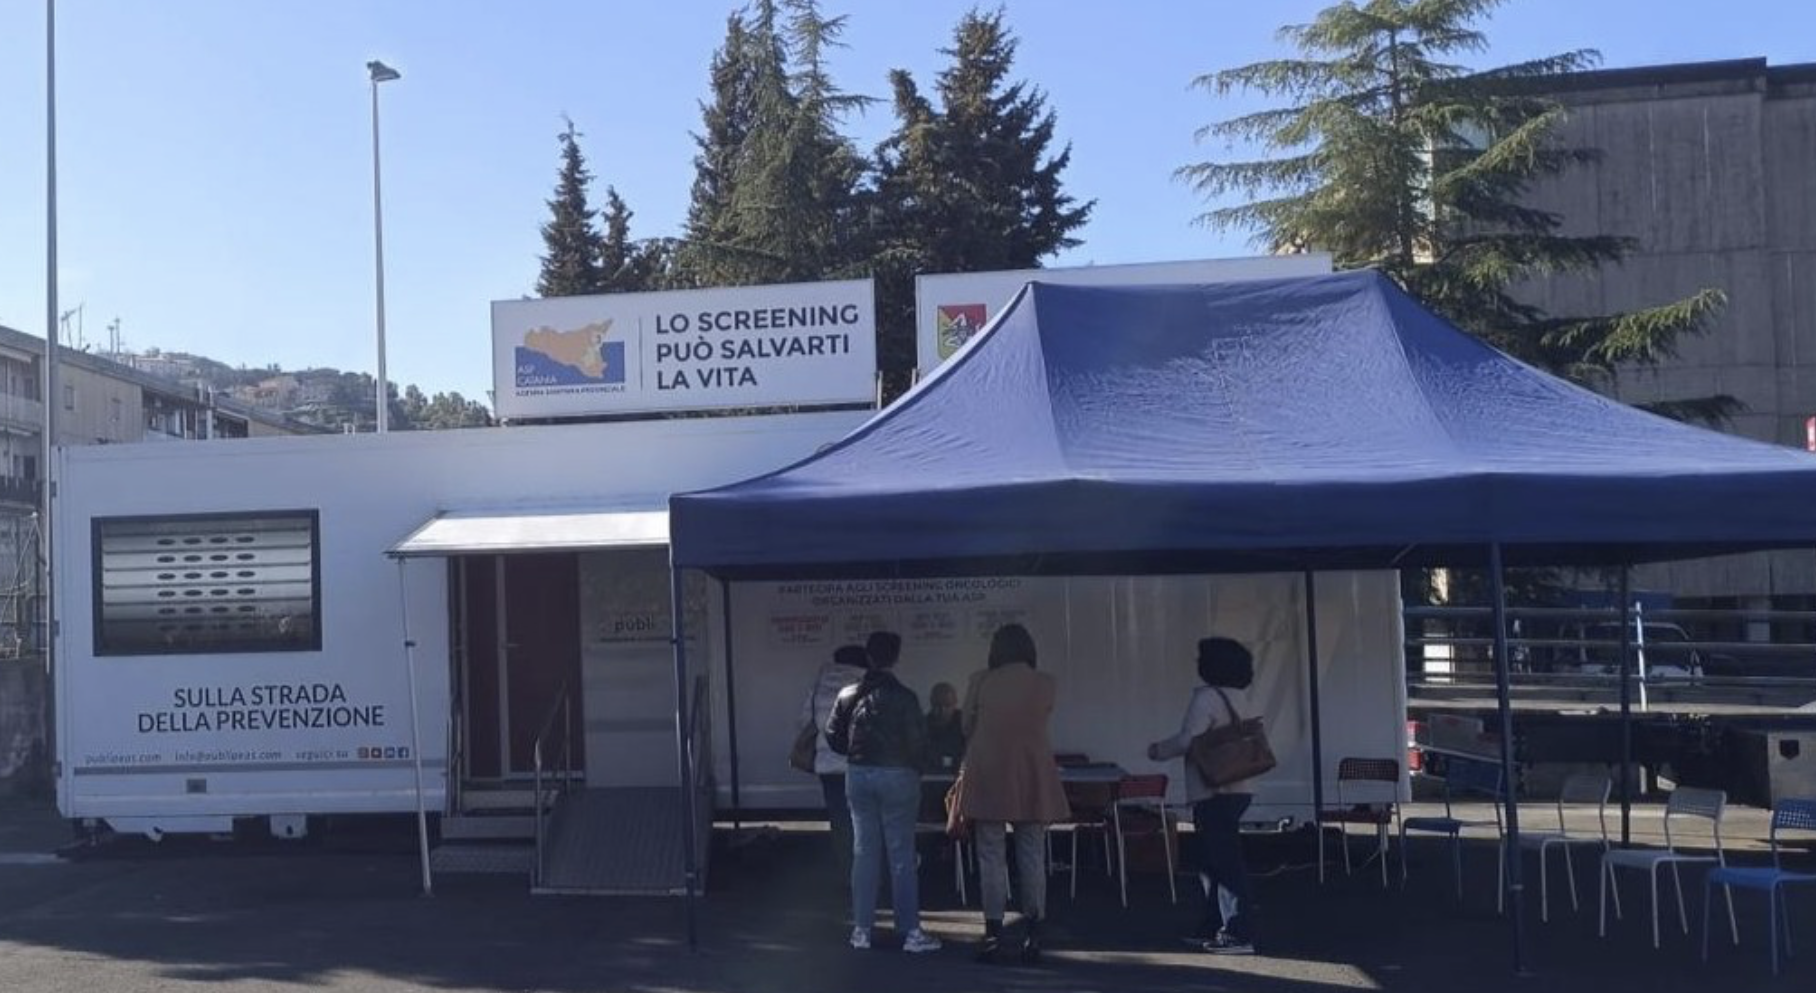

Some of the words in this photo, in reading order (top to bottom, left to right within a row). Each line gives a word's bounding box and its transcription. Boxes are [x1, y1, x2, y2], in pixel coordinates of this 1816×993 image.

[655, 313, 690, 335] LO
[697, 304, 859, 332] SCREENING
[656, 335, 714, 363] PUÒ
[720, 334, 850, 360] SALVARTI
[517, 375, 558, 386] CATANIA
[656, 369, 690, 390] LA
[696, 366, 758, 388] VITA
[173, 686, 247, 708] SULLA
[250, 683, 347, 706] STRADA
[137, 711, 211, 733] DELLA
[215, 704, 385, 731] PREVENZIONE
